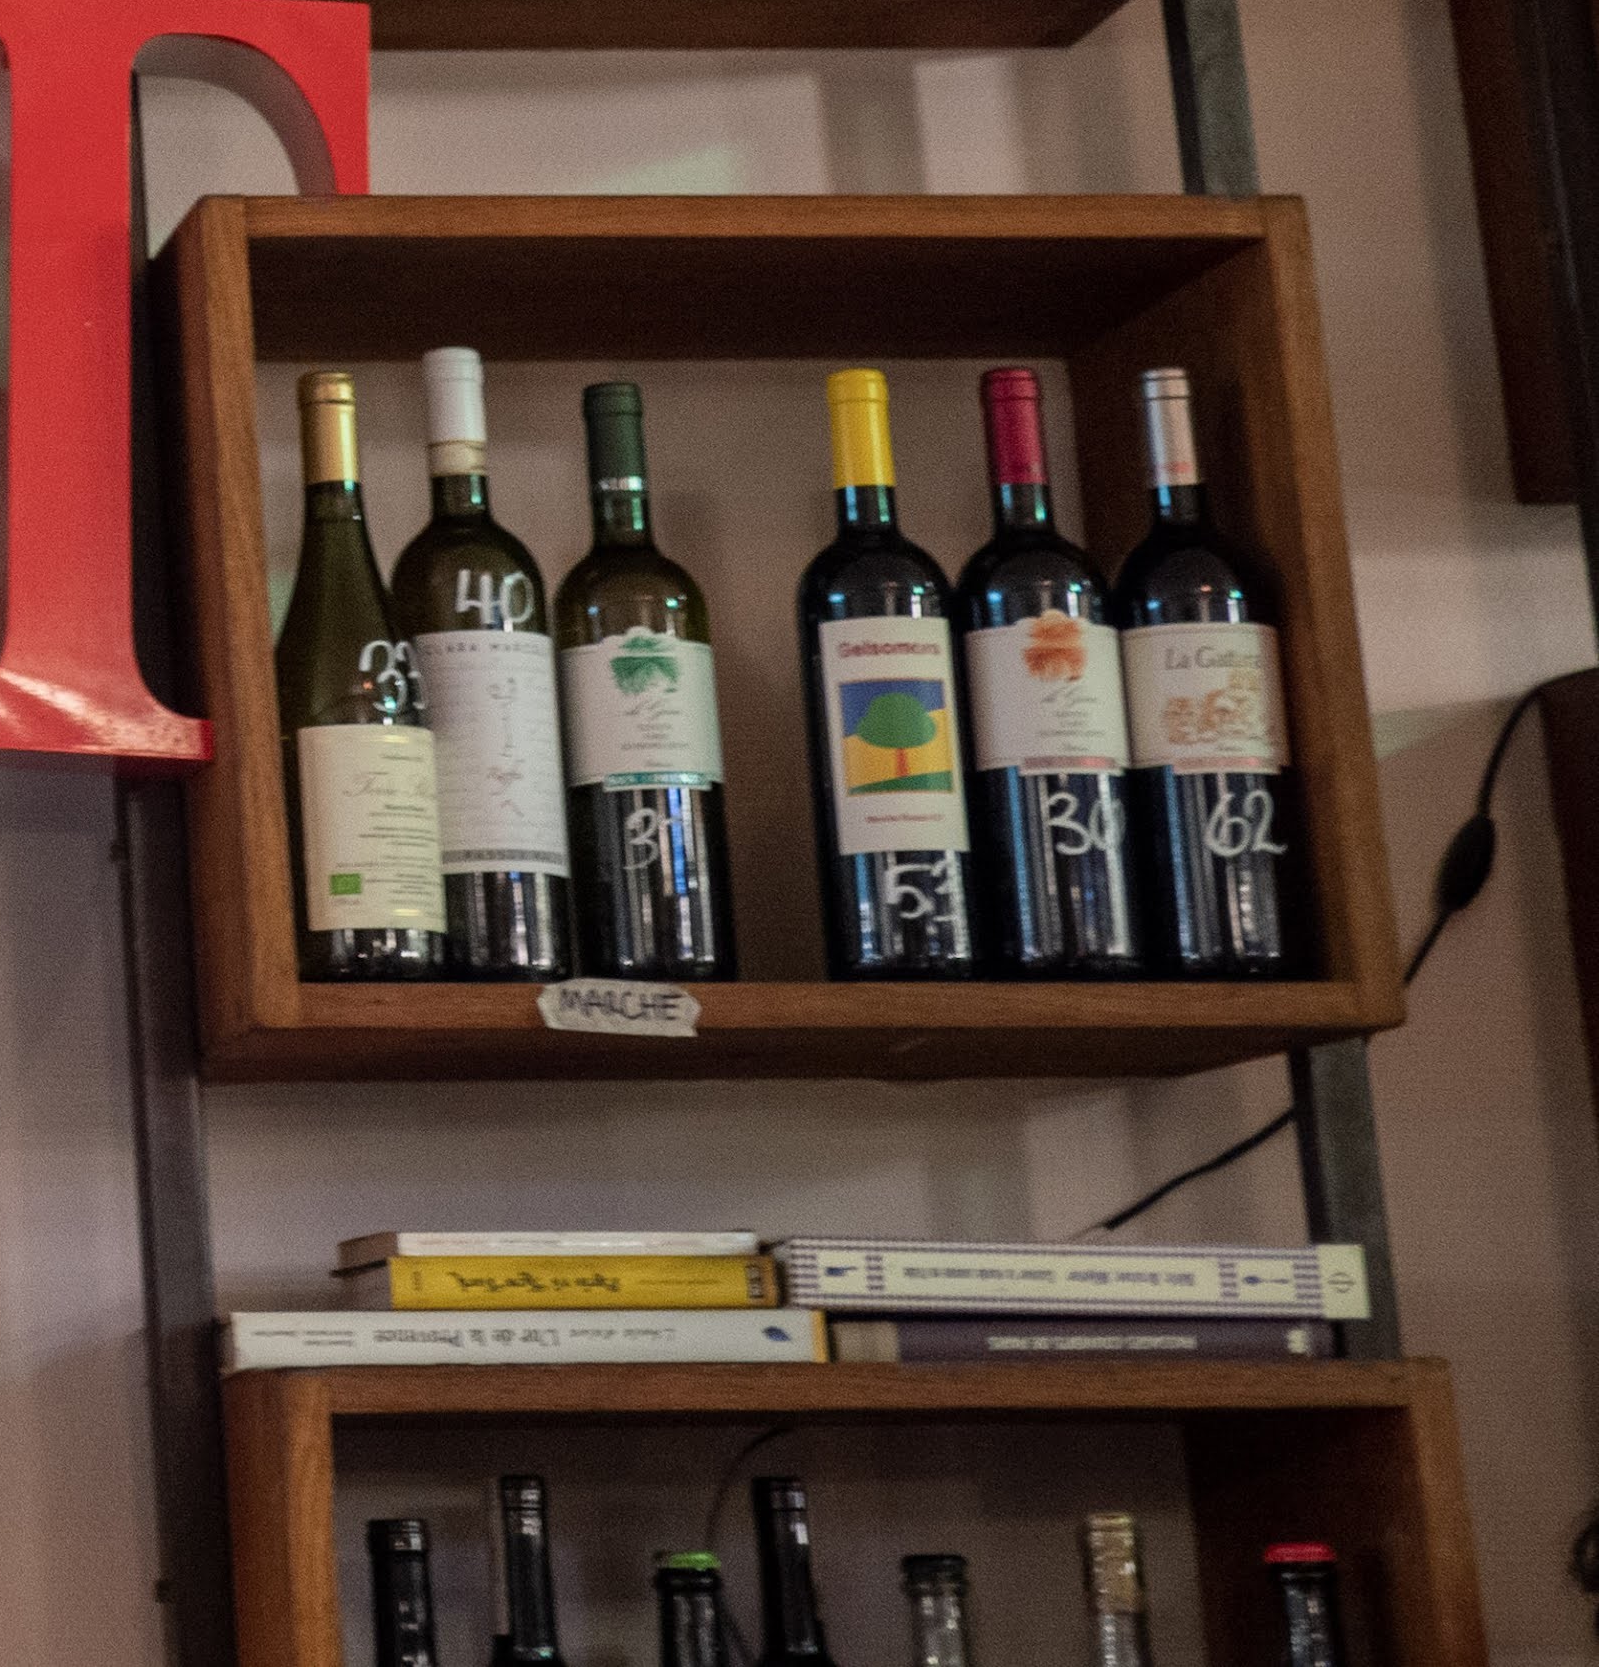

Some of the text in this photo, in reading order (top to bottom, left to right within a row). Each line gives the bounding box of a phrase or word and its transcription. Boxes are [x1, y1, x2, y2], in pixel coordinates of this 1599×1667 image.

[456, 569, 534, 624] 40
[1206, 790, 1288, 857] 62
[561, 988, 681, 1023] MARCHE
